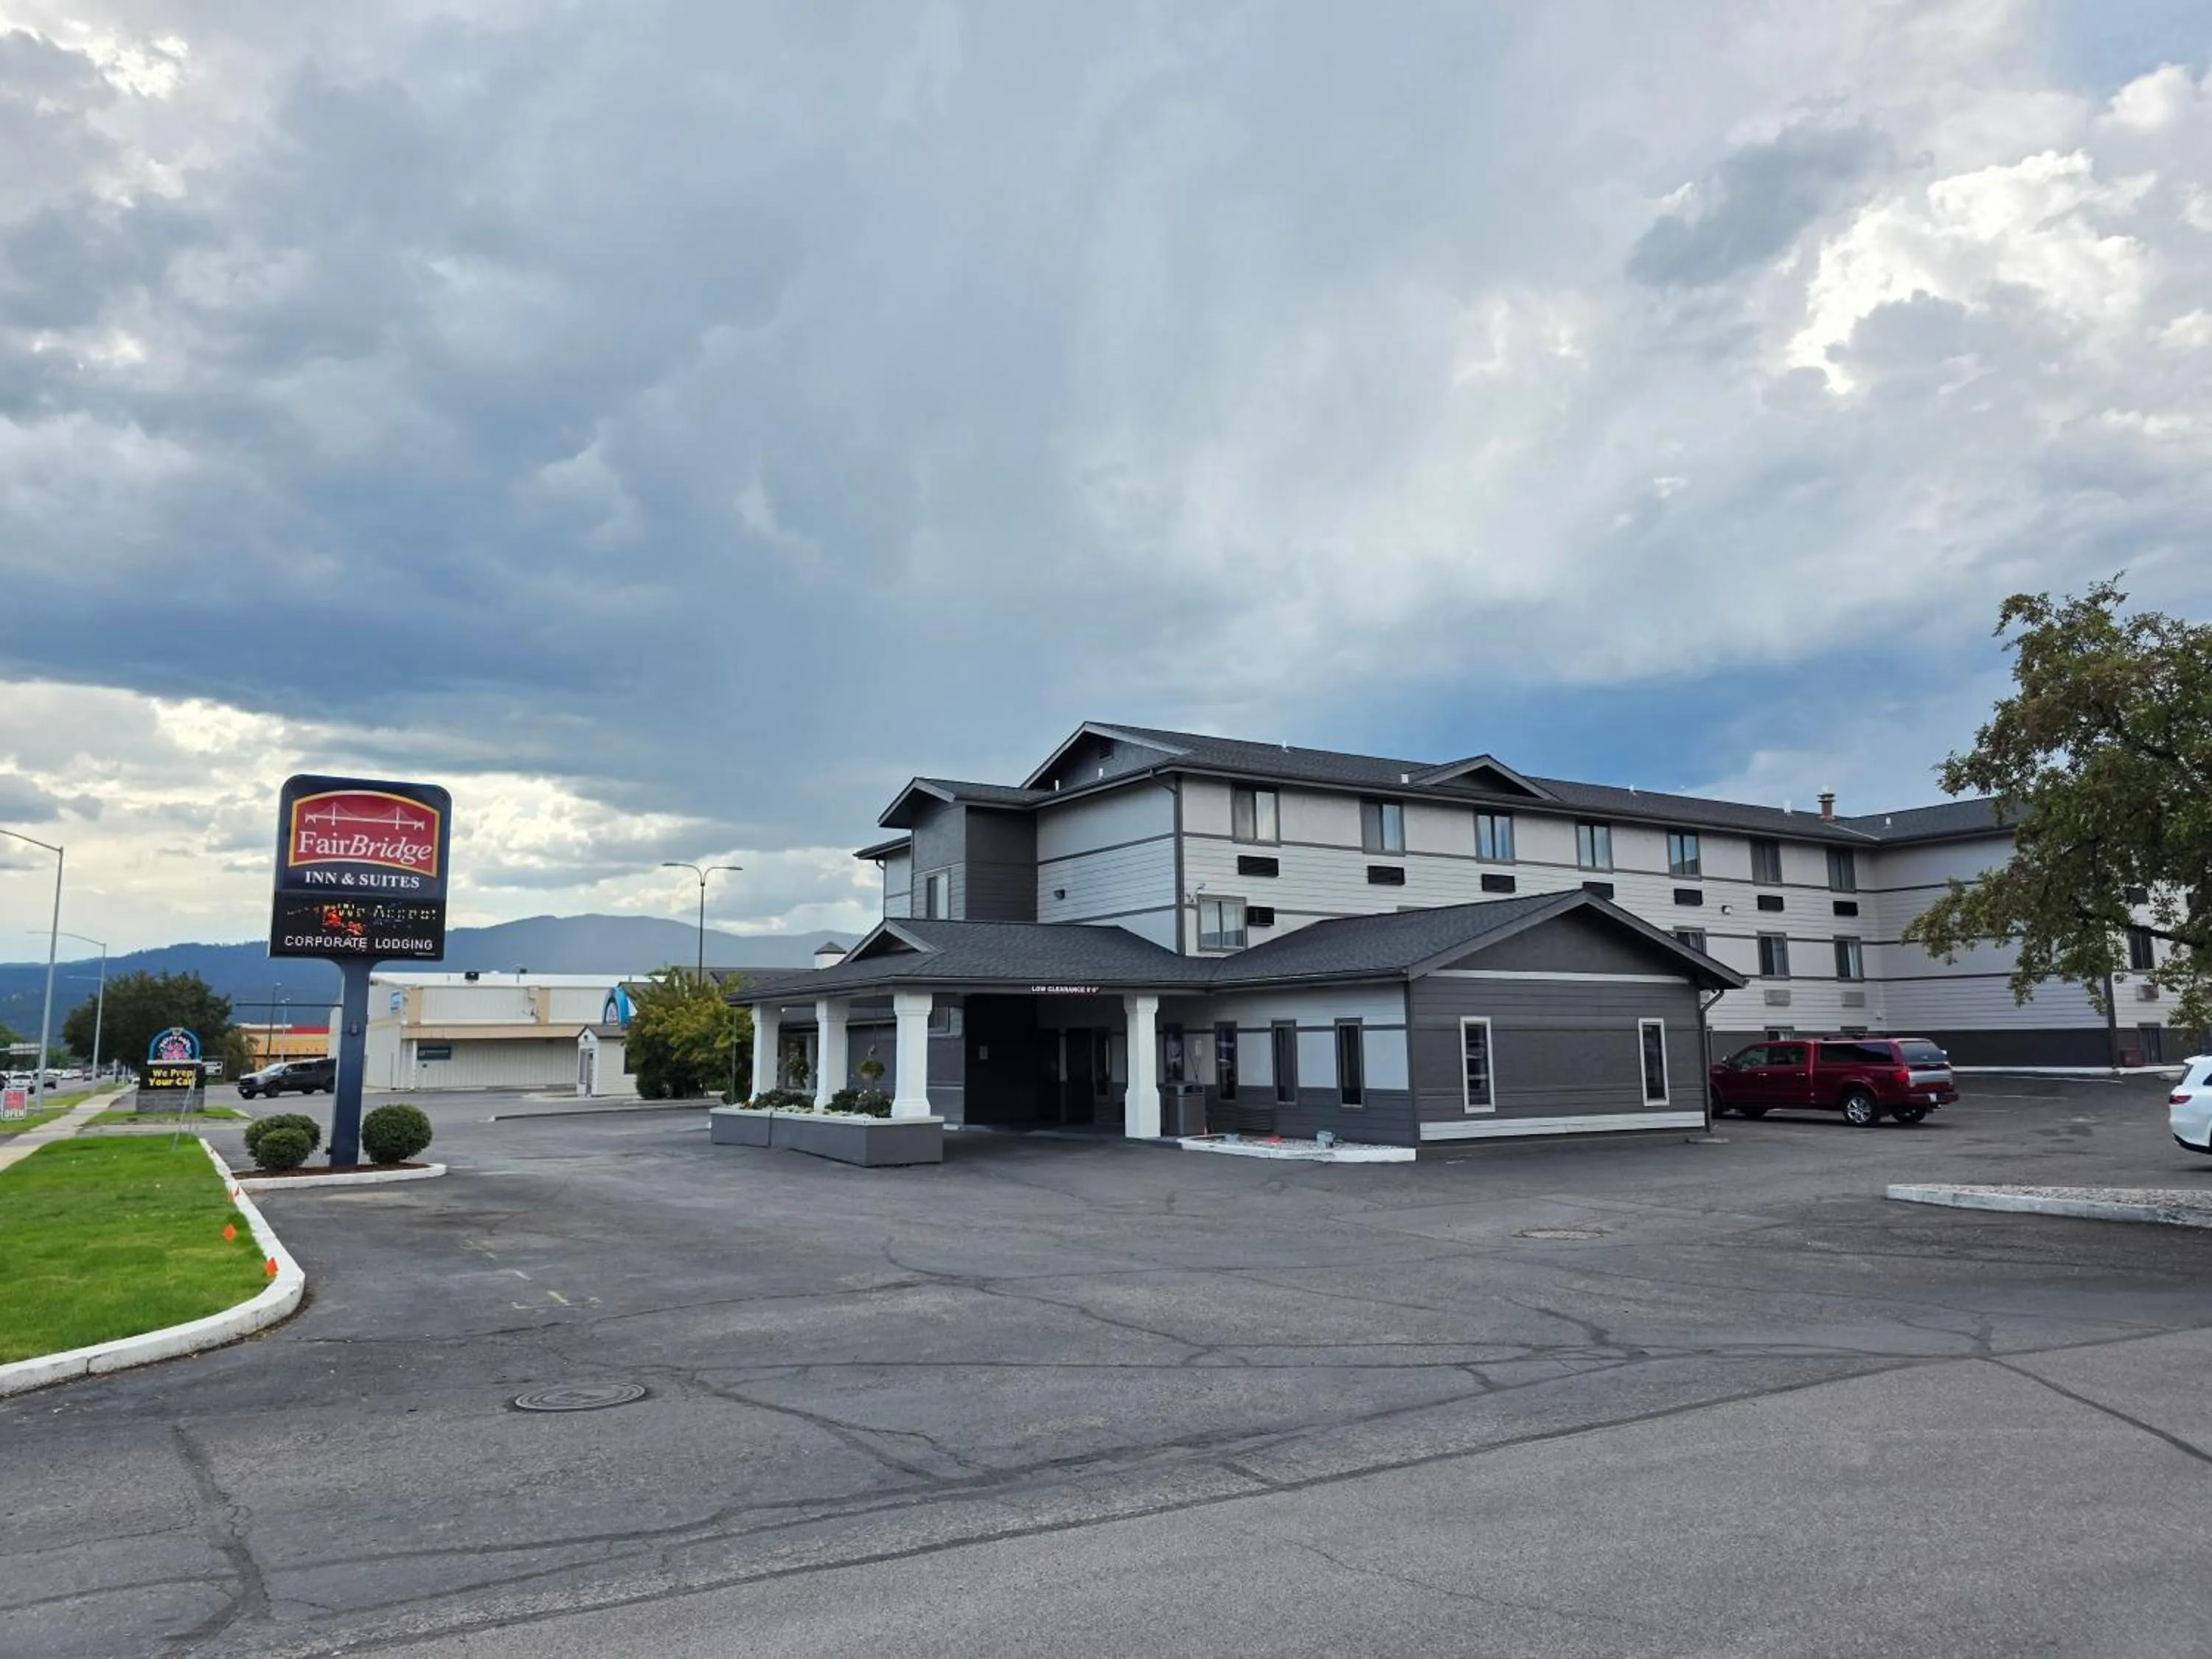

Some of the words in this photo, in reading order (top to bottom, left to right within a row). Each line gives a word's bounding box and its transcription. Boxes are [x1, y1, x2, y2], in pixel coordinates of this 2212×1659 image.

[297, 830, 433, 865] FairBridge
[305, 871, 337, 885] INN
[341, 872, 355, 886] &
[359, 874, 420, 888] SUITES
[284, 936, 368, 948] CORPORATE
[375, 938, 434, 950] LODGING
[153, 1069, 168, 1077] We
[170, 1069, 193, 1079] Prep
[148, 1077, 173, 1086] Your
